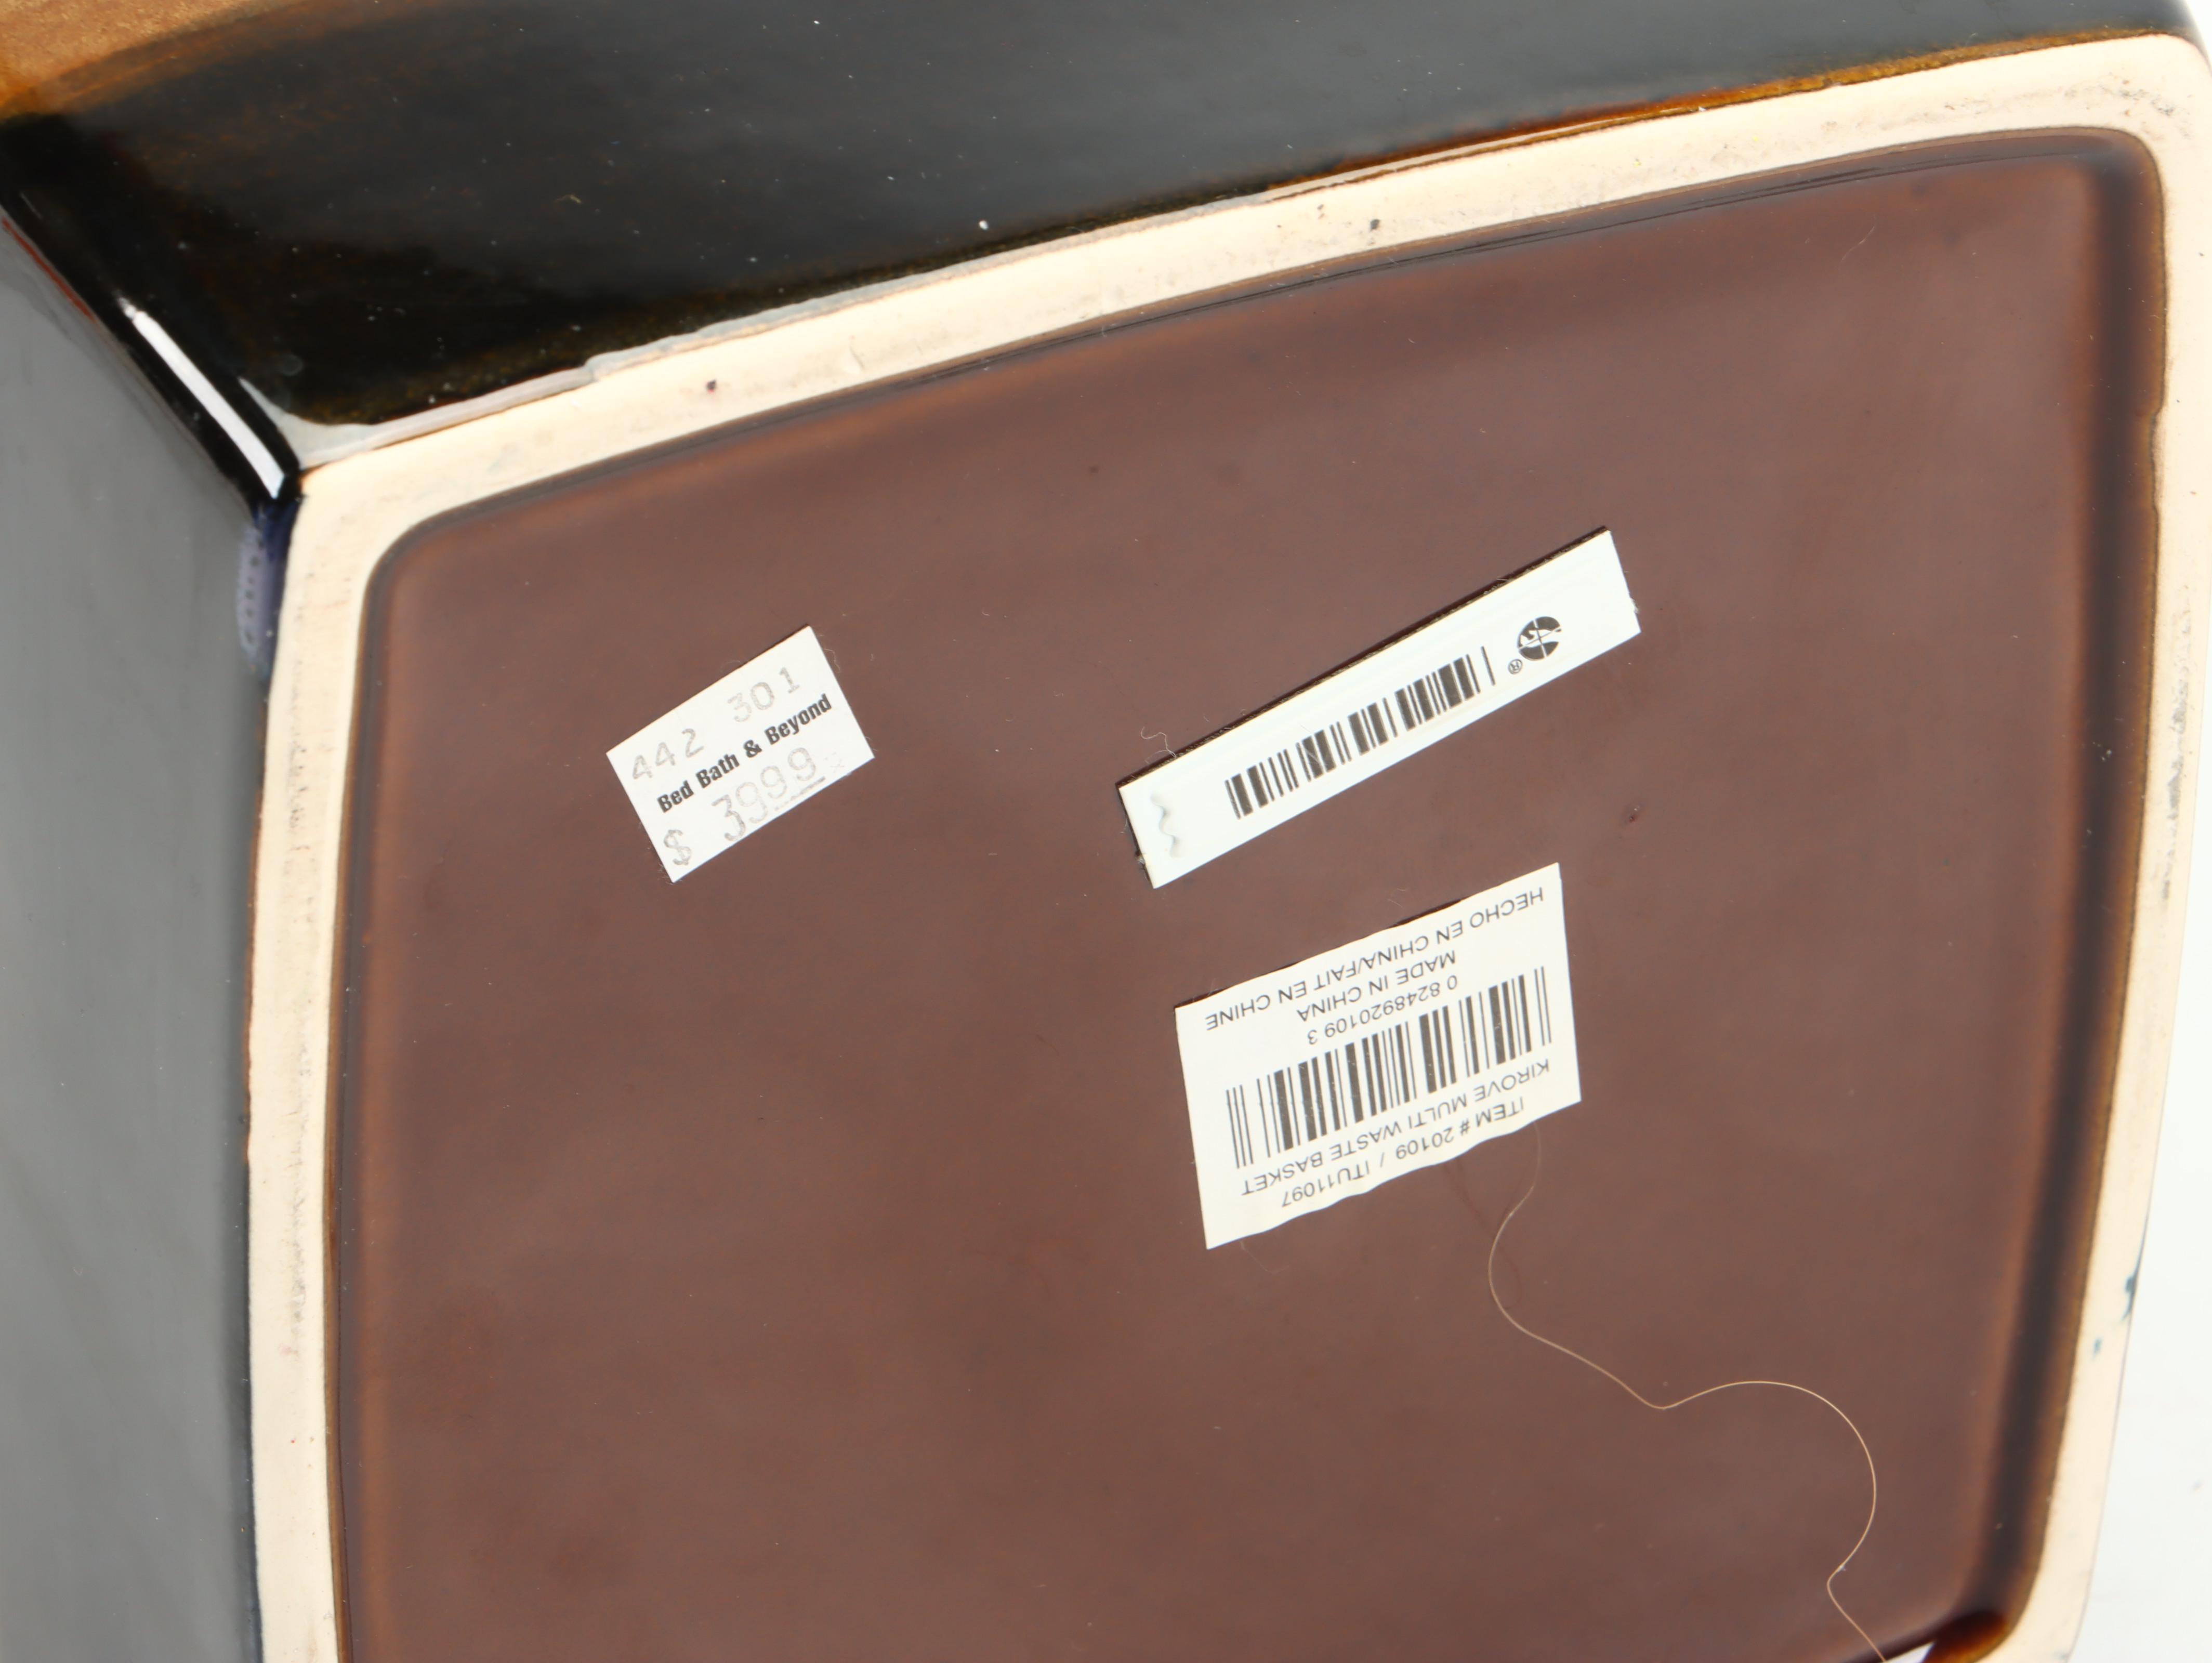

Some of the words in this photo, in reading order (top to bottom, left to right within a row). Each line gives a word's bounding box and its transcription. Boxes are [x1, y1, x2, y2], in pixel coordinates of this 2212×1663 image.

[633, 728, 704, 780] 442
[728, 667, 800, 722] 301
[657, 781, 694, 812] Bed
[696, 753, 739, 788] Bath
[744, 740, 762, 758] &
[765, 694, 832, 745] Beyond
[1470, 888, 1543, 928] HECHO
[1436, 921, 1464, 944] EN
[1369, 975, 1389, 995] IN
[1395, 951, 1456, 985] MADE
[1447, 975, 1458, 989] 0
[1279, 981, 1307, 1004] EN
[1296, 987, 1363, 1022] CHINA
[1205, 994, 1270, 1030] CHINE
[1325, 983, 1441, 1038] 8248920109
[1308, 1030, 1318, 1045] 3
[1474, 1059, 1549, 1101] KIROVE
[1408, 1095, 1467, 1129] MULTI
[1459, 1119, 1470, 1135] #
[1475, 1097, 1524, 1127] ITEM
[1330, 1121, 1402, 1160] WASTE
[1396, 1129, 1455, 1160] 20109
[1241, 1154, 1324, 1196] BASKET
[1281, 1159, 1370, 1207] ITU11097
